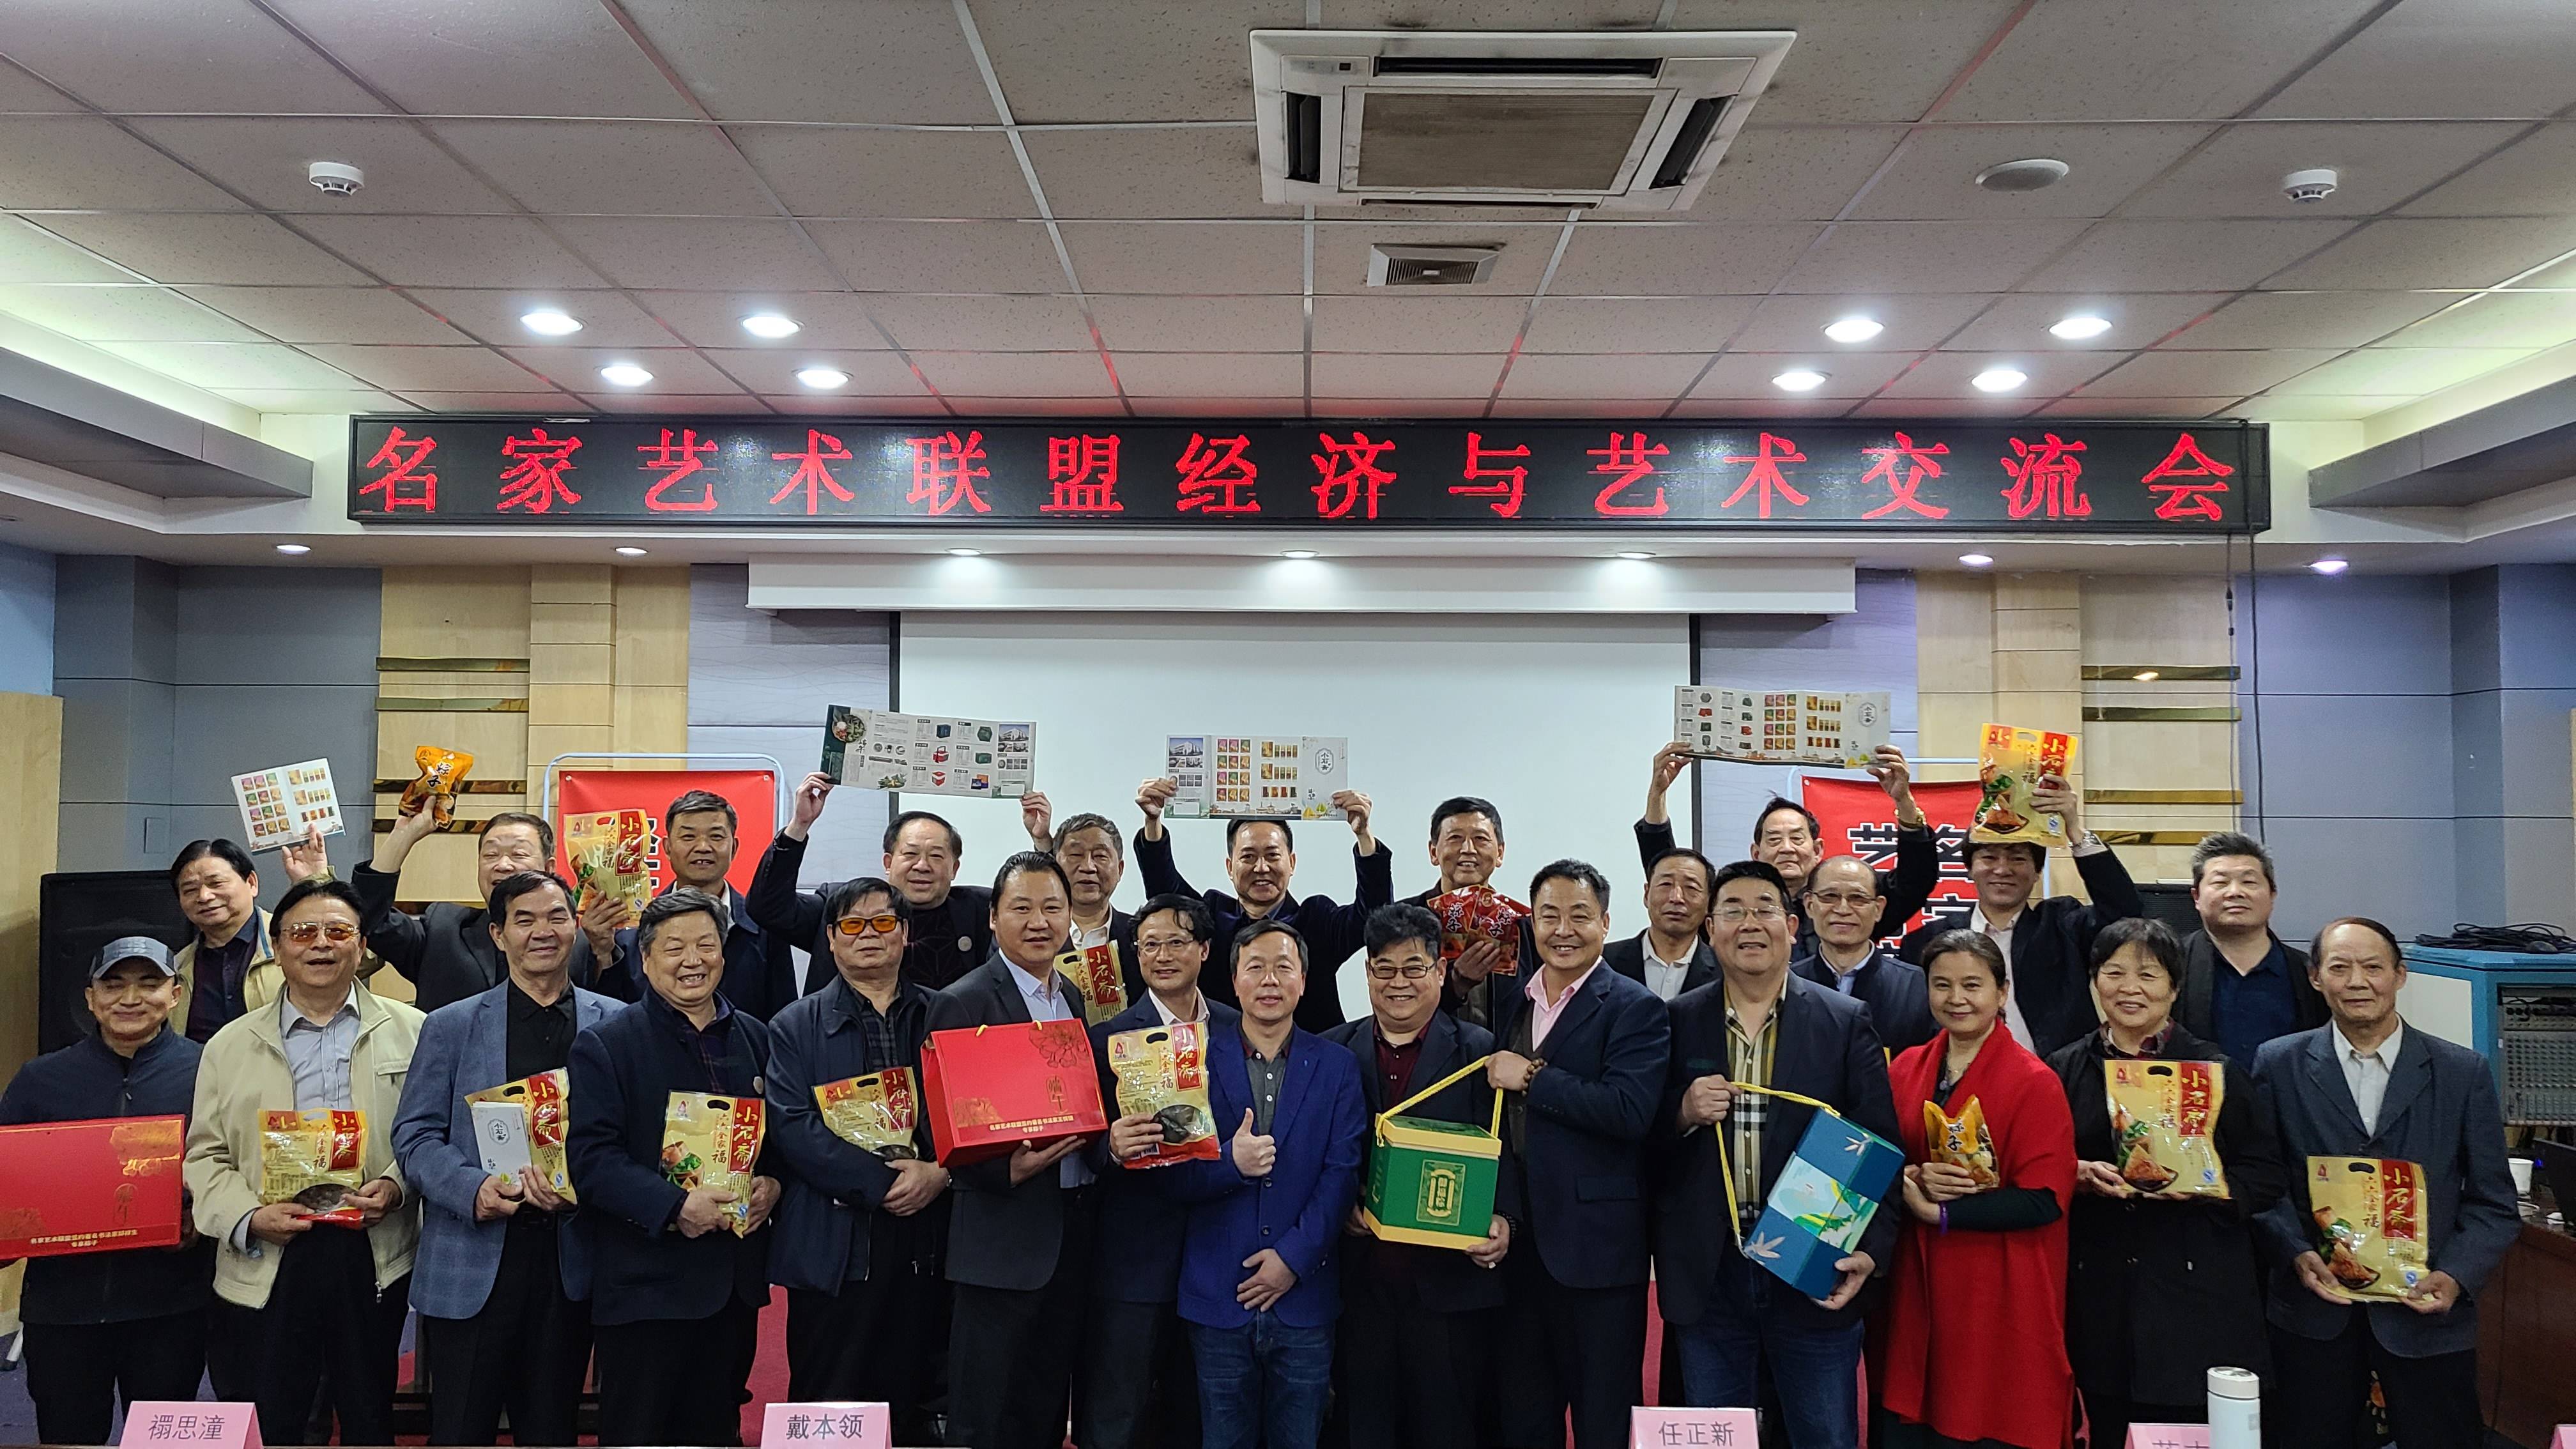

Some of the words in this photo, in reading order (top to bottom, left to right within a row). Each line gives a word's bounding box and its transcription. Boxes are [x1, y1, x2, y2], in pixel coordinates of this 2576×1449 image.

[358, 427, 2236, 523] 名家艺术联盟经济与艺术交流会
[1089, 951, 1116, 998] 小石斋
[733, 1106, 759, 1165] 小石斋
[2384, 1168, 2418, 1229] 小石斋
[148, 1414, 225, 1441] 禤思潼
[786, 1413, 864, 1440] 戴本领
[1659, 1420, 1735, 1447] 任正新
